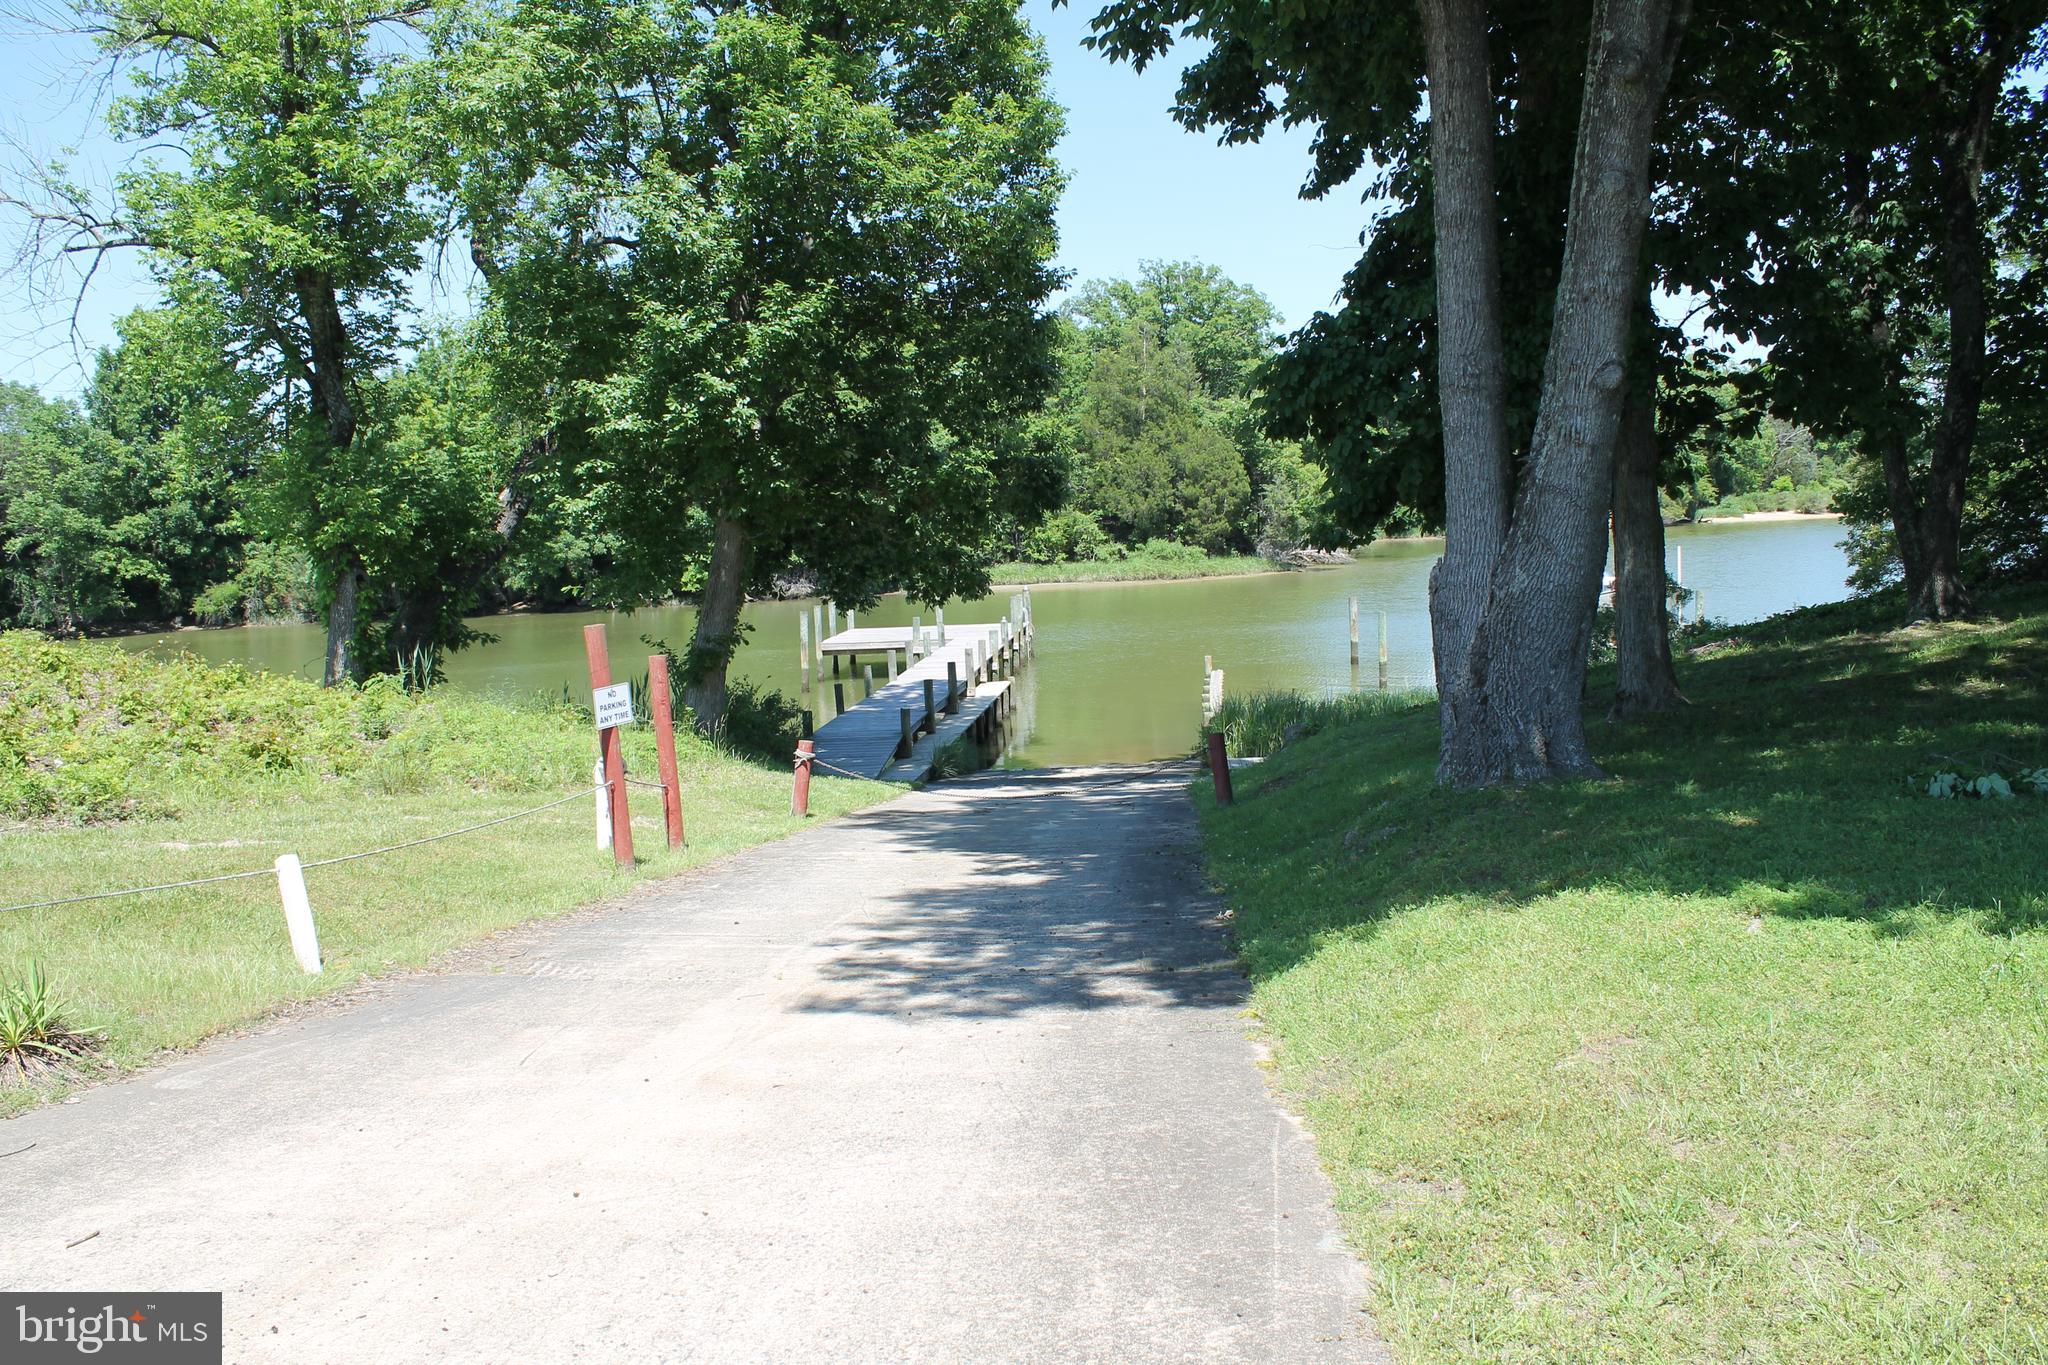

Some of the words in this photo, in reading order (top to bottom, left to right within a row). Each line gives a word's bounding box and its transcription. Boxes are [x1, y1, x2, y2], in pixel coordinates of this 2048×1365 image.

[607, 690, 617, 698] NO
[600, 700, 627, 712] PARKING
[600, 715, 613, 724] ANY
[614, 711, 629, 720] TIME
